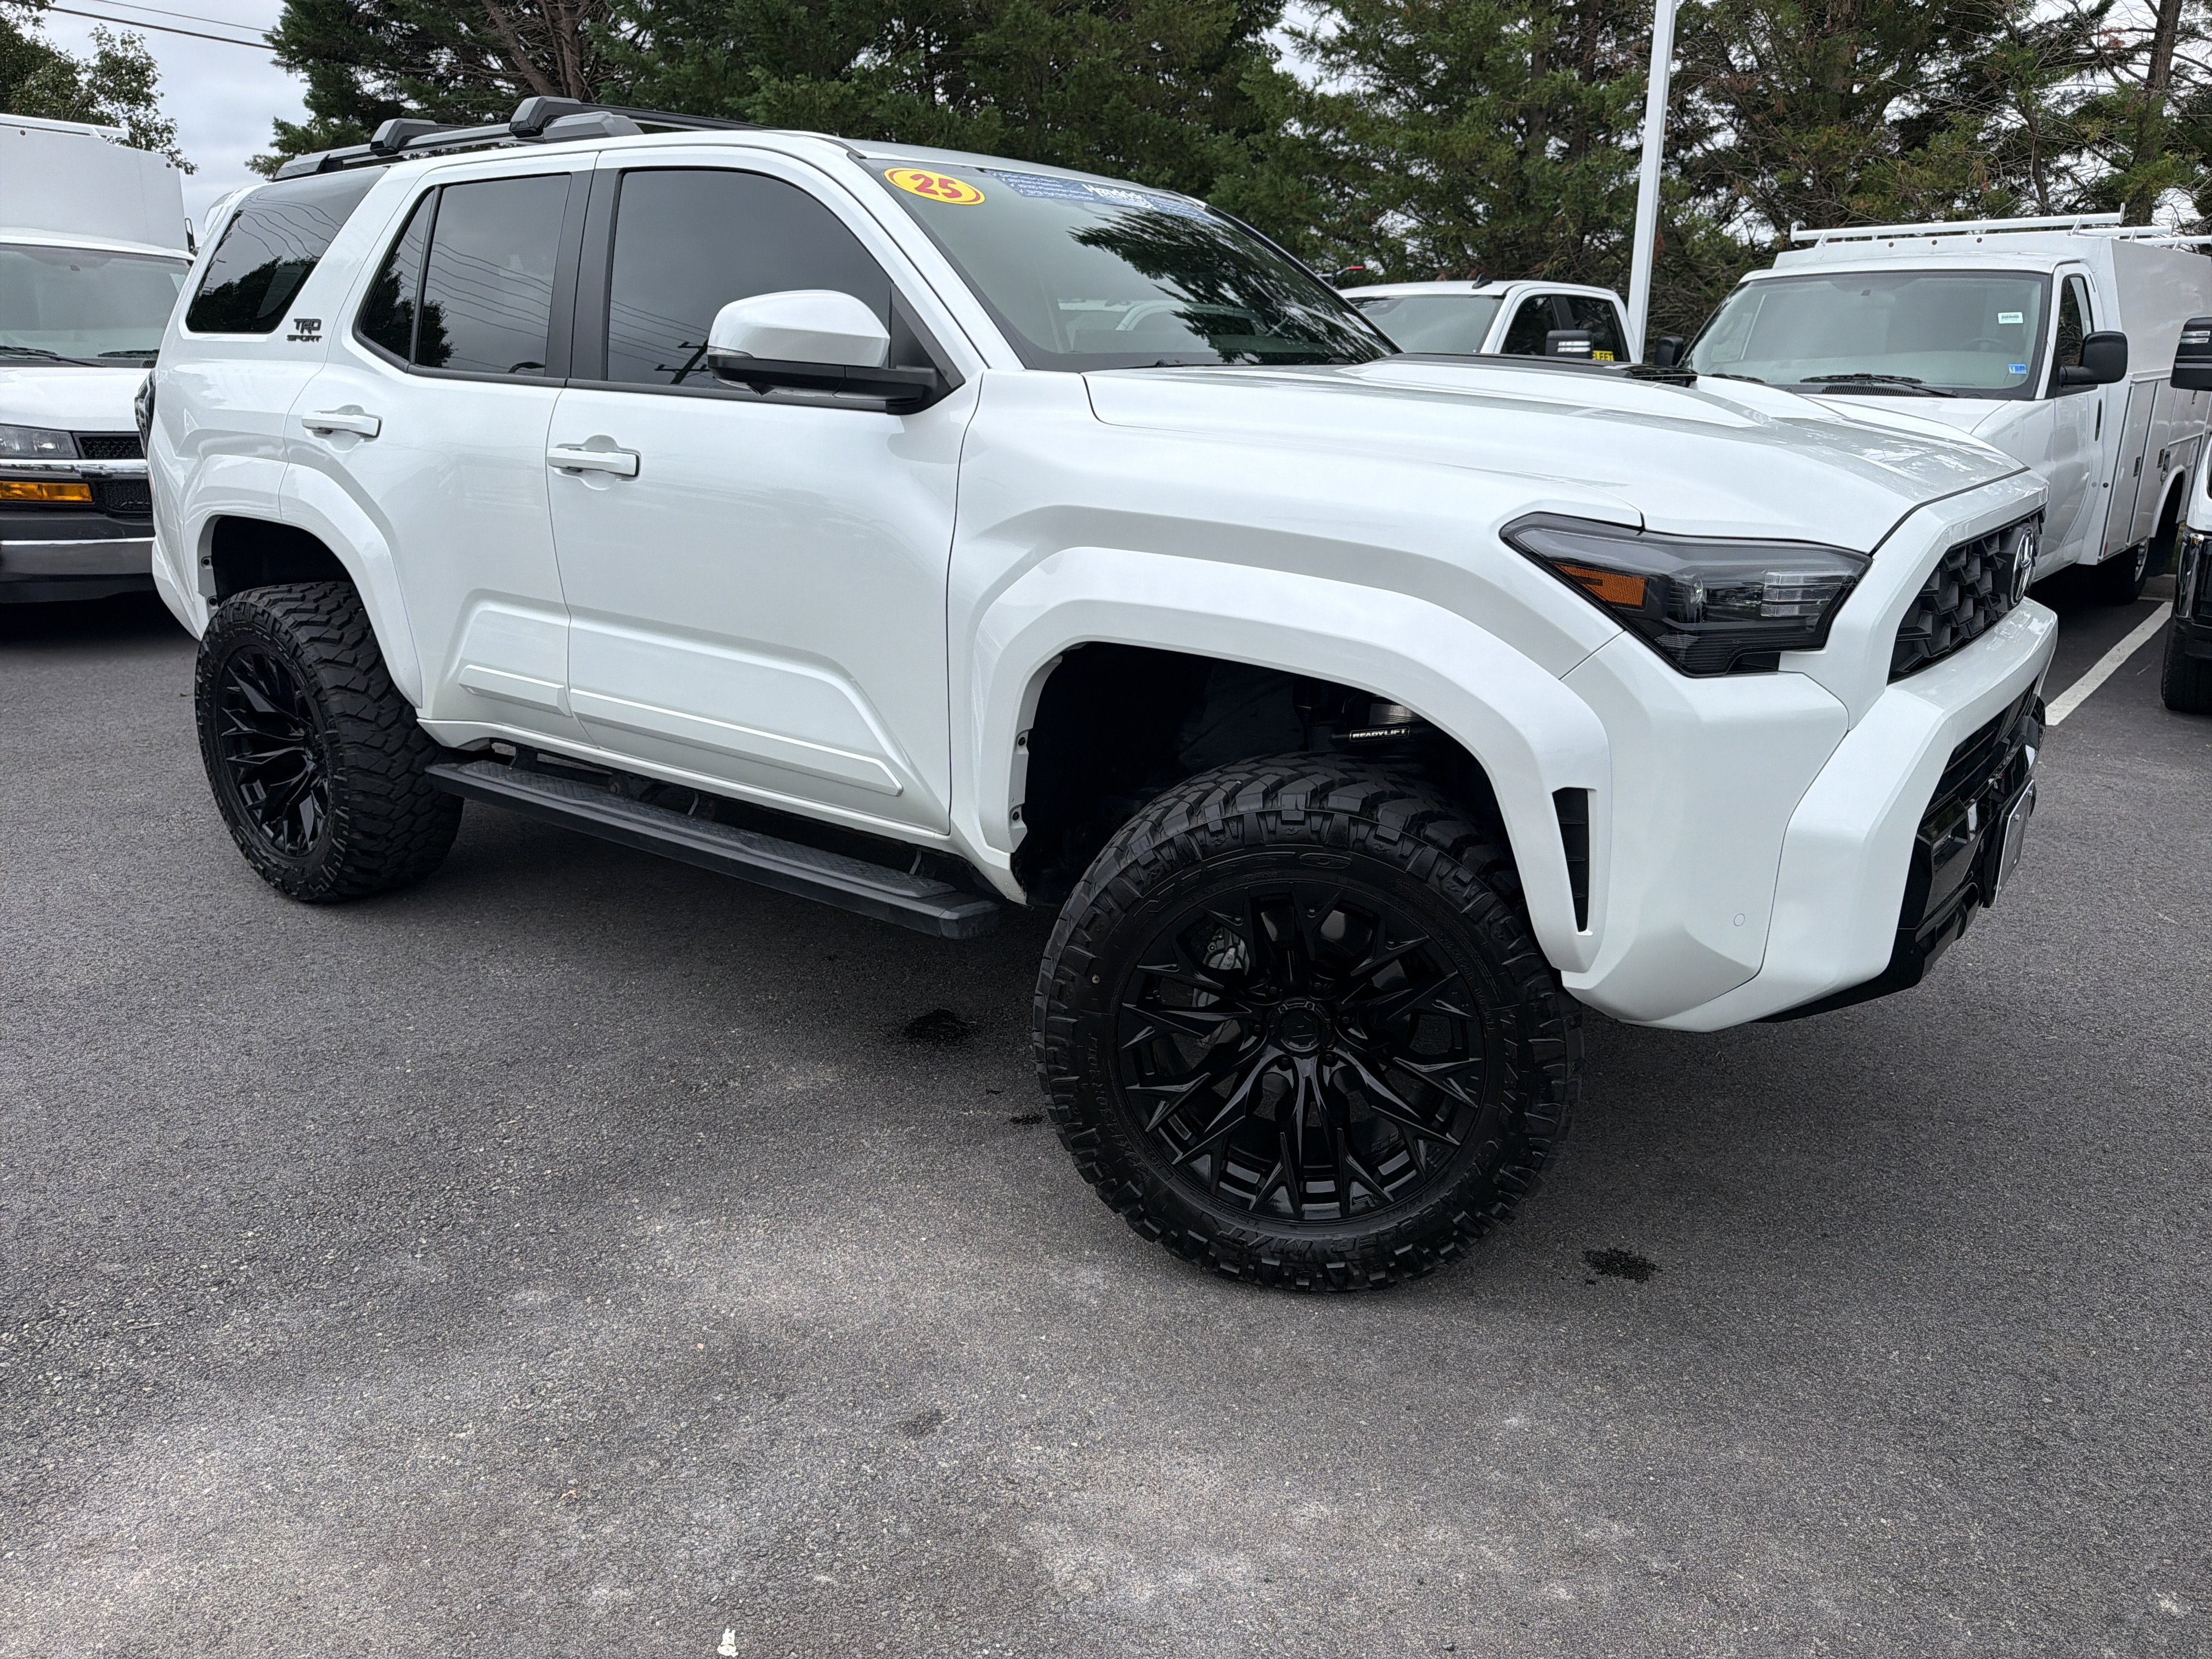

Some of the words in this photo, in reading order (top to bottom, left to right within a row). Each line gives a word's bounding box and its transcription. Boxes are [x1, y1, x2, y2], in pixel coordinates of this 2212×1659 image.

[910, 174, 962, 198] 25
[294, 318, 321, 334] TRD
[1353, 729, 1407, 738] READYLIFT
